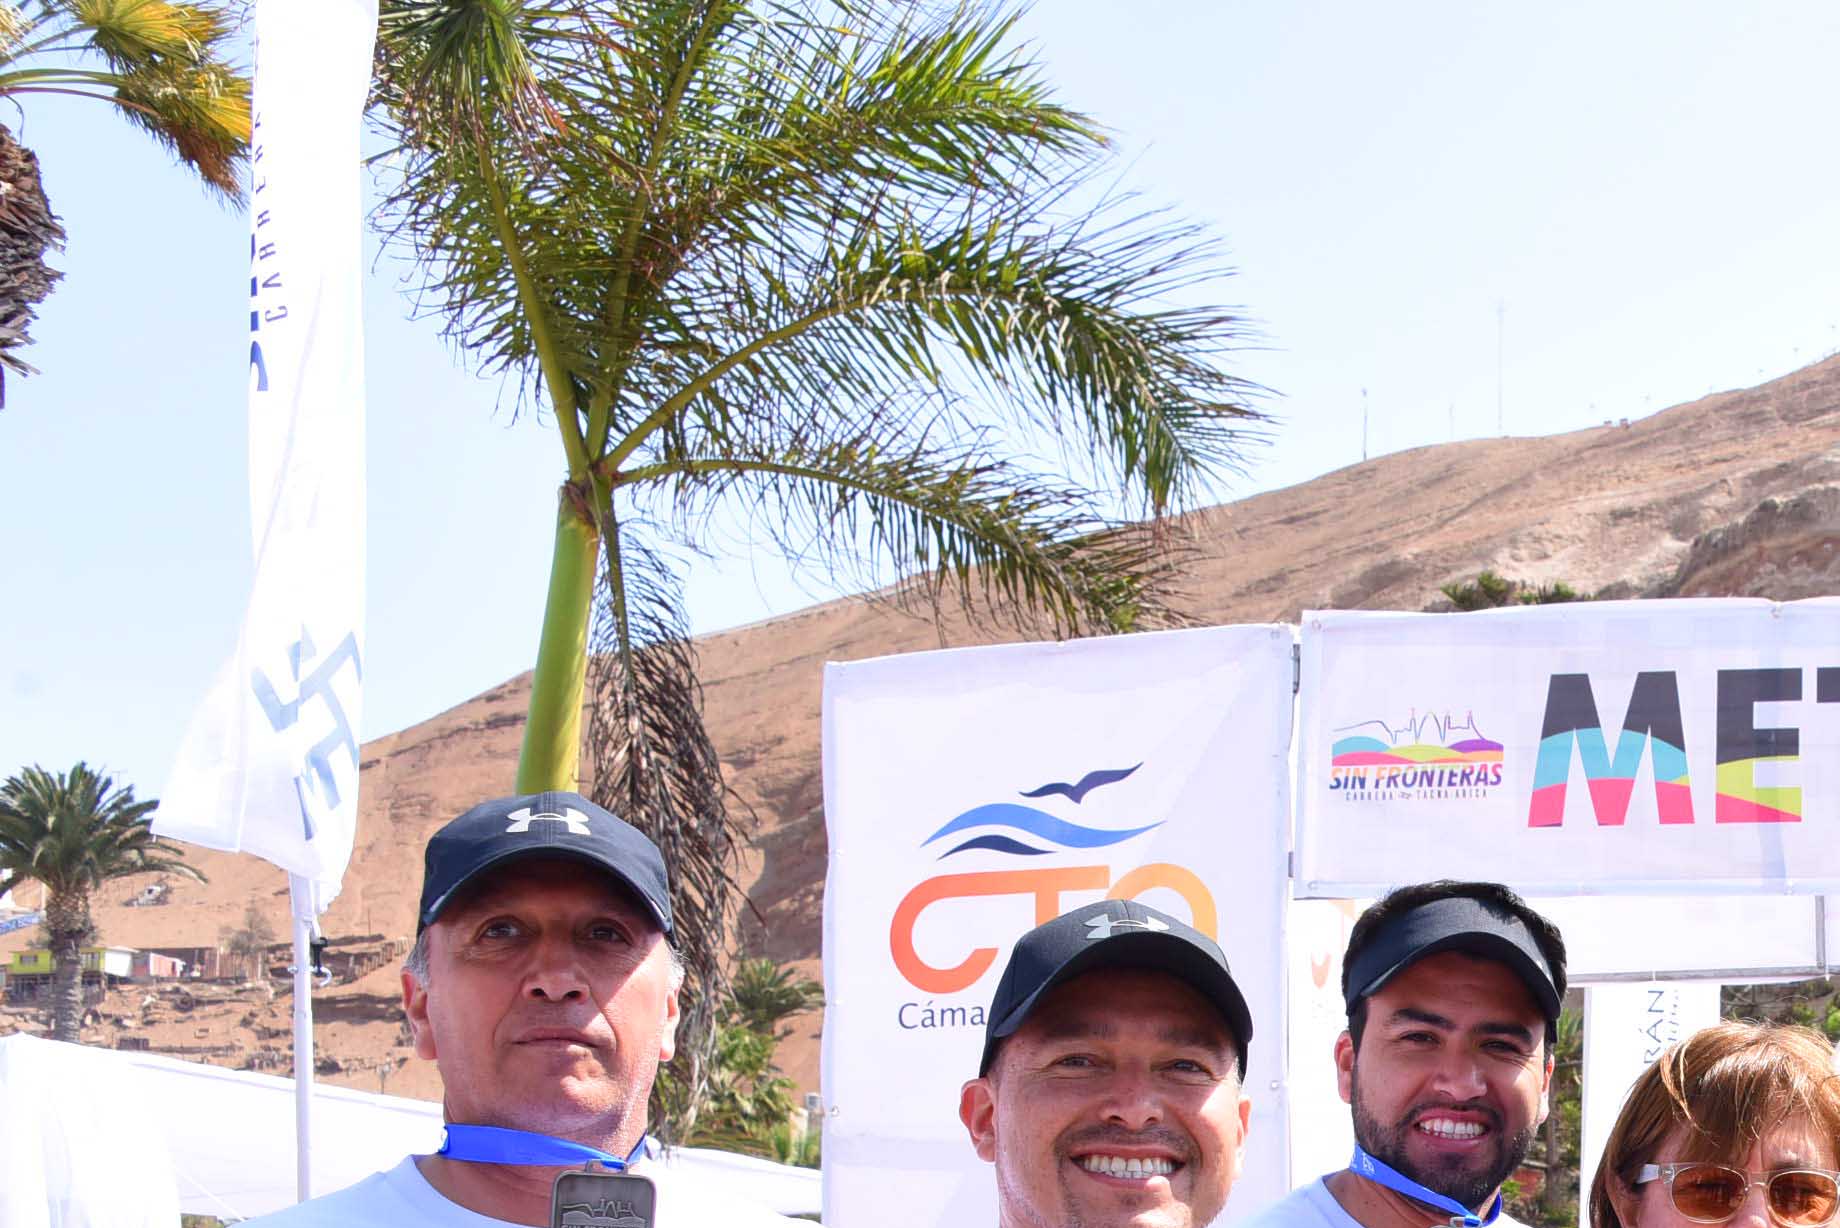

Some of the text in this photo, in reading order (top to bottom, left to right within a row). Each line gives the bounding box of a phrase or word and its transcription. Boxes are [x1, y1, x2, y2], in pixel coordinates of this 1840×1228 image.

[1329, 763, 1503, 790] SIN FRONTERAS
[898, 1000, 987, 1032] Cáma
[1637, 989, 1665, 1064] RÁN
